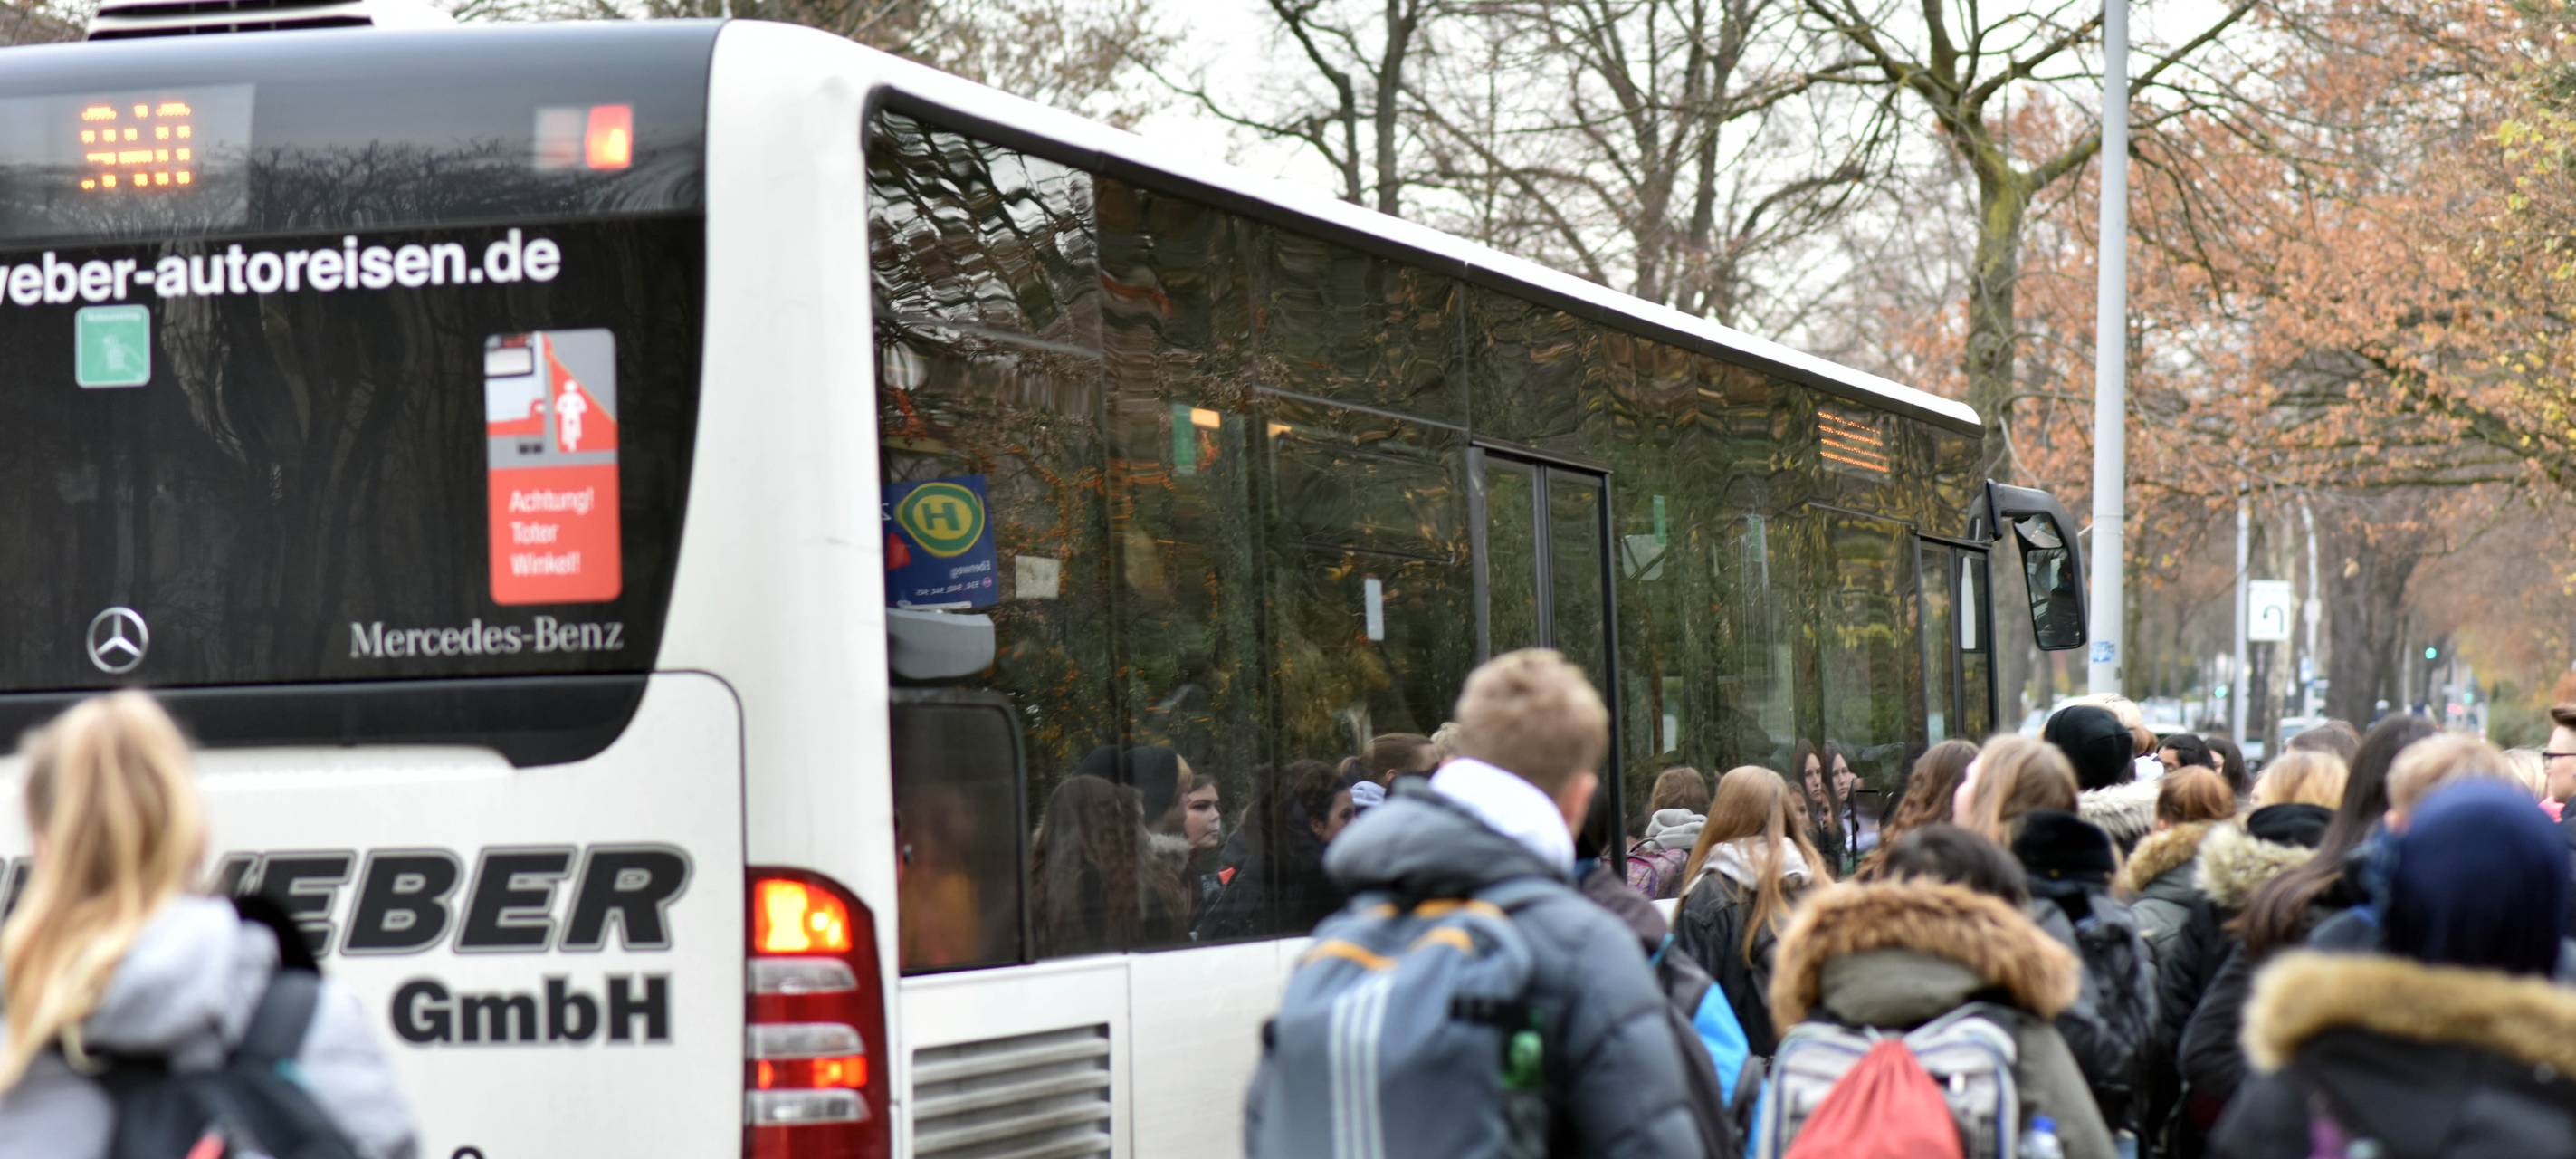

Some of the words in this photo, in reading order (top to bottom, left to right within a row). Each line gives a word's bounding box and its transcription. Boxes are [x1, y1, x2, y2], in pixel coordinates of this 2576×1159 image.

[509, 486, 595, 515] Achtung!
[510, 521, 559, 543] Toter
[510, 551, 580, 576] Winkel!
[350, 616, 625, 658] Mercedes-Benz
[208, 841, 695, 956] EBER
[388, 972, 673, 1044] GmbH
